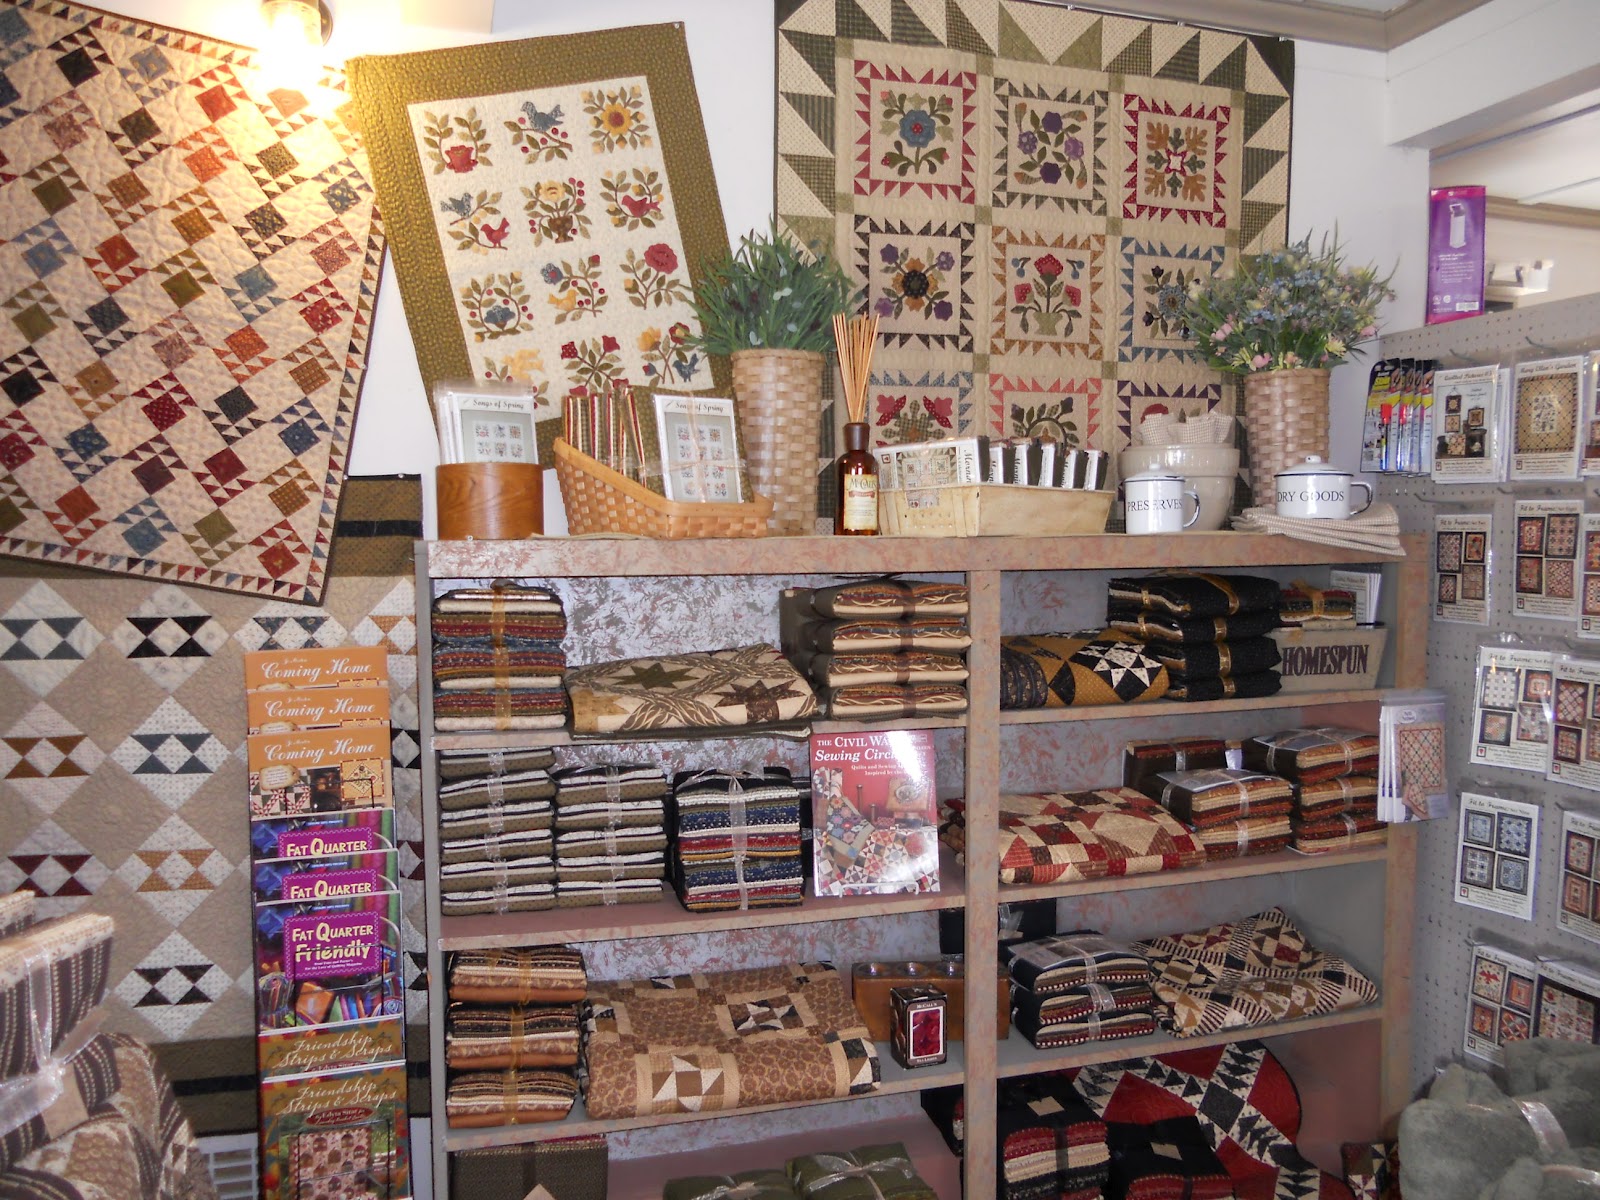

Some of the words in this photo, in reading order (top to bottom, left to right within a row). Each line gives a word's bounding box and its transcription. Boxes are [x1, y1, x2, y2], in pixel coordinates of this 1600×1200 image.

[473, 399, 493, 409] Songs
[494, 401, 501, 410] of
[503, 400, 524, 411] Spring
[703, 403, 724, 413] Spring
[1127, 499, 1182, 512] PRESERVES
[1277, 491, 1296, 502] DRY
[1299, 491, 1344, 502] GOODS
[261, 663, 321, 682] Coming
[326, 658, 372, 675] Home
[1281, 645, 1370, 677] HOMESPUN
[265, 701, 324, 721] Coming
[329, 698, 376, 715] Home
[264, 744, 324, 764] Coming
[329, 738, 376, 756] Home
[834, 736, 867, 748] CIVIL
[869, 735, 892, 747] WA
[815, 749, 861, 762] Sewing
[286, 843, 308, 857] FAT
[310, 838, 367, 856] QUARTER
[290, 886, 312, 899] FAT
[314, 880, 372, 898] QUARTER
[292, 928, 314, 942] FAT
[316, 922, 374, 942] QUARTER
[295, 939, 372, 963] Friendly
[290, 1031, 373, 1053] Friendship
[272, 1052, 326, 1071] Strips
[329, 1050, 339, 1060] &
[341, 1044, 393, 1062] Scraps
[294, 1077, 377, 1101] Friendship
[276, 1099, 330, 1118] Strips
[333, 1096, 343, 1106] &
[345, 1090, 397, 1108] Scraps
